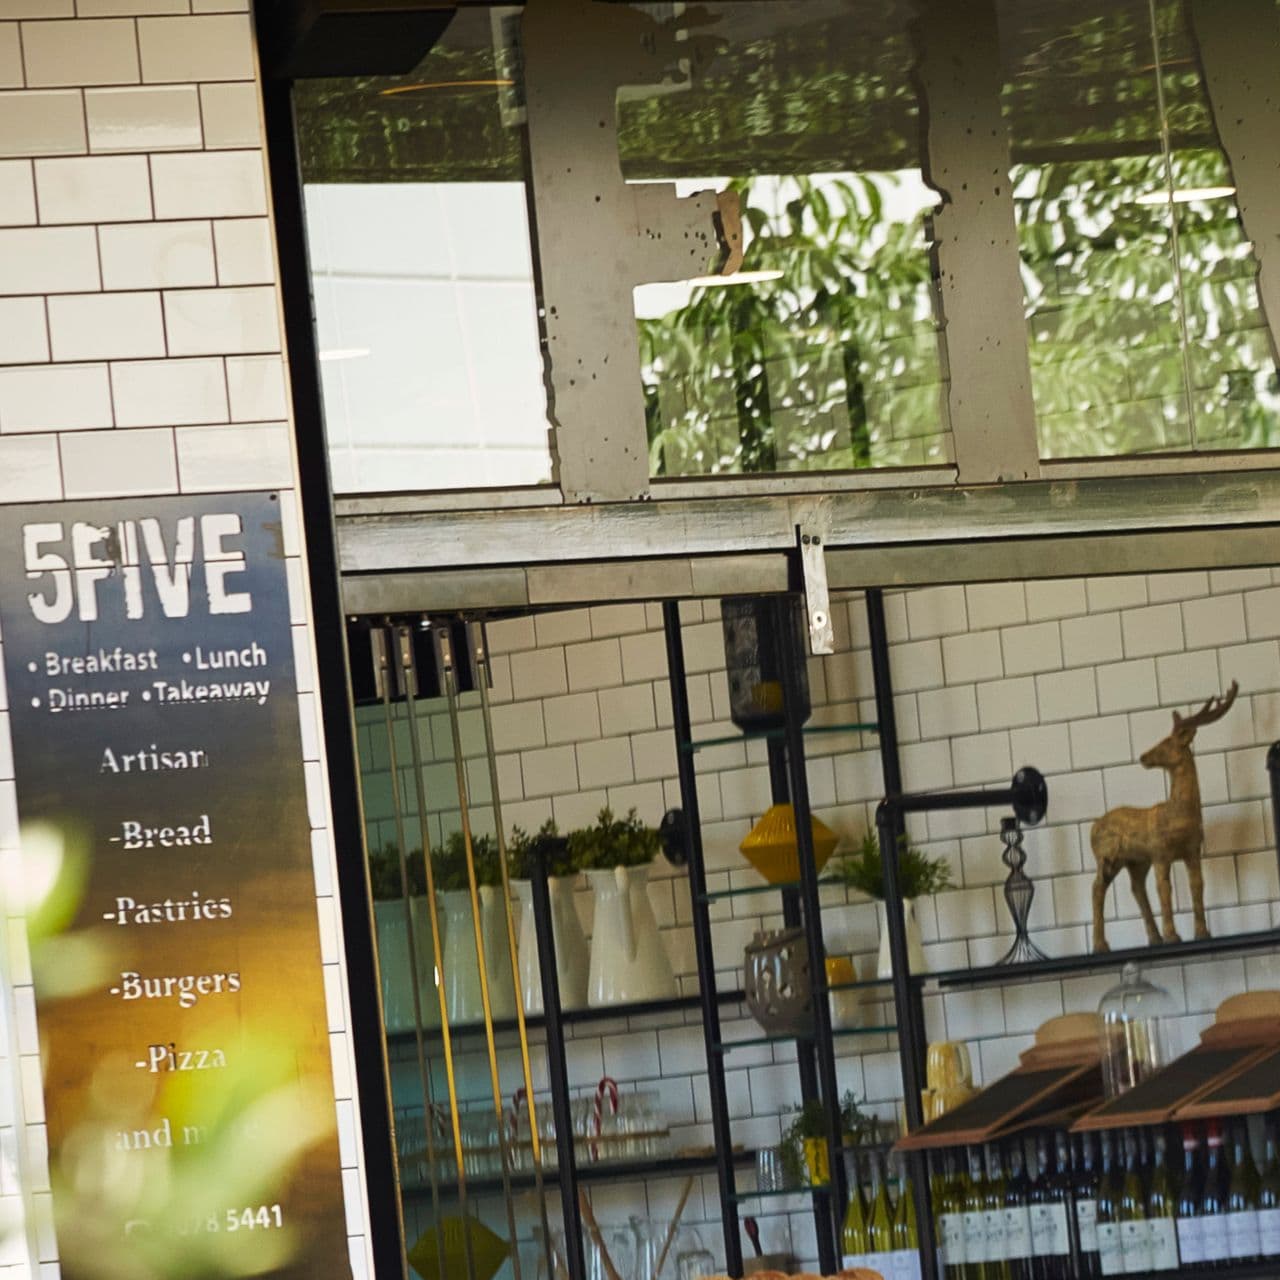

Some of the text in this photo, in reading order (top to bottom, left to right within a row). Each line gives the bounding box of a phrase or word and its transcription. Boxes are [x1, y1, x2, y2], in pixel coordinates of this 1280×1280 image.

[23, 514, 252, 624] 5FIVE
[45, 642, 268, 676] Breakfast Lunch
[49, 680, 271, 713] Dinner Takeaway
[115, 1117, 174, 1151] and
[226, 1203, 284, 1232] 5441
